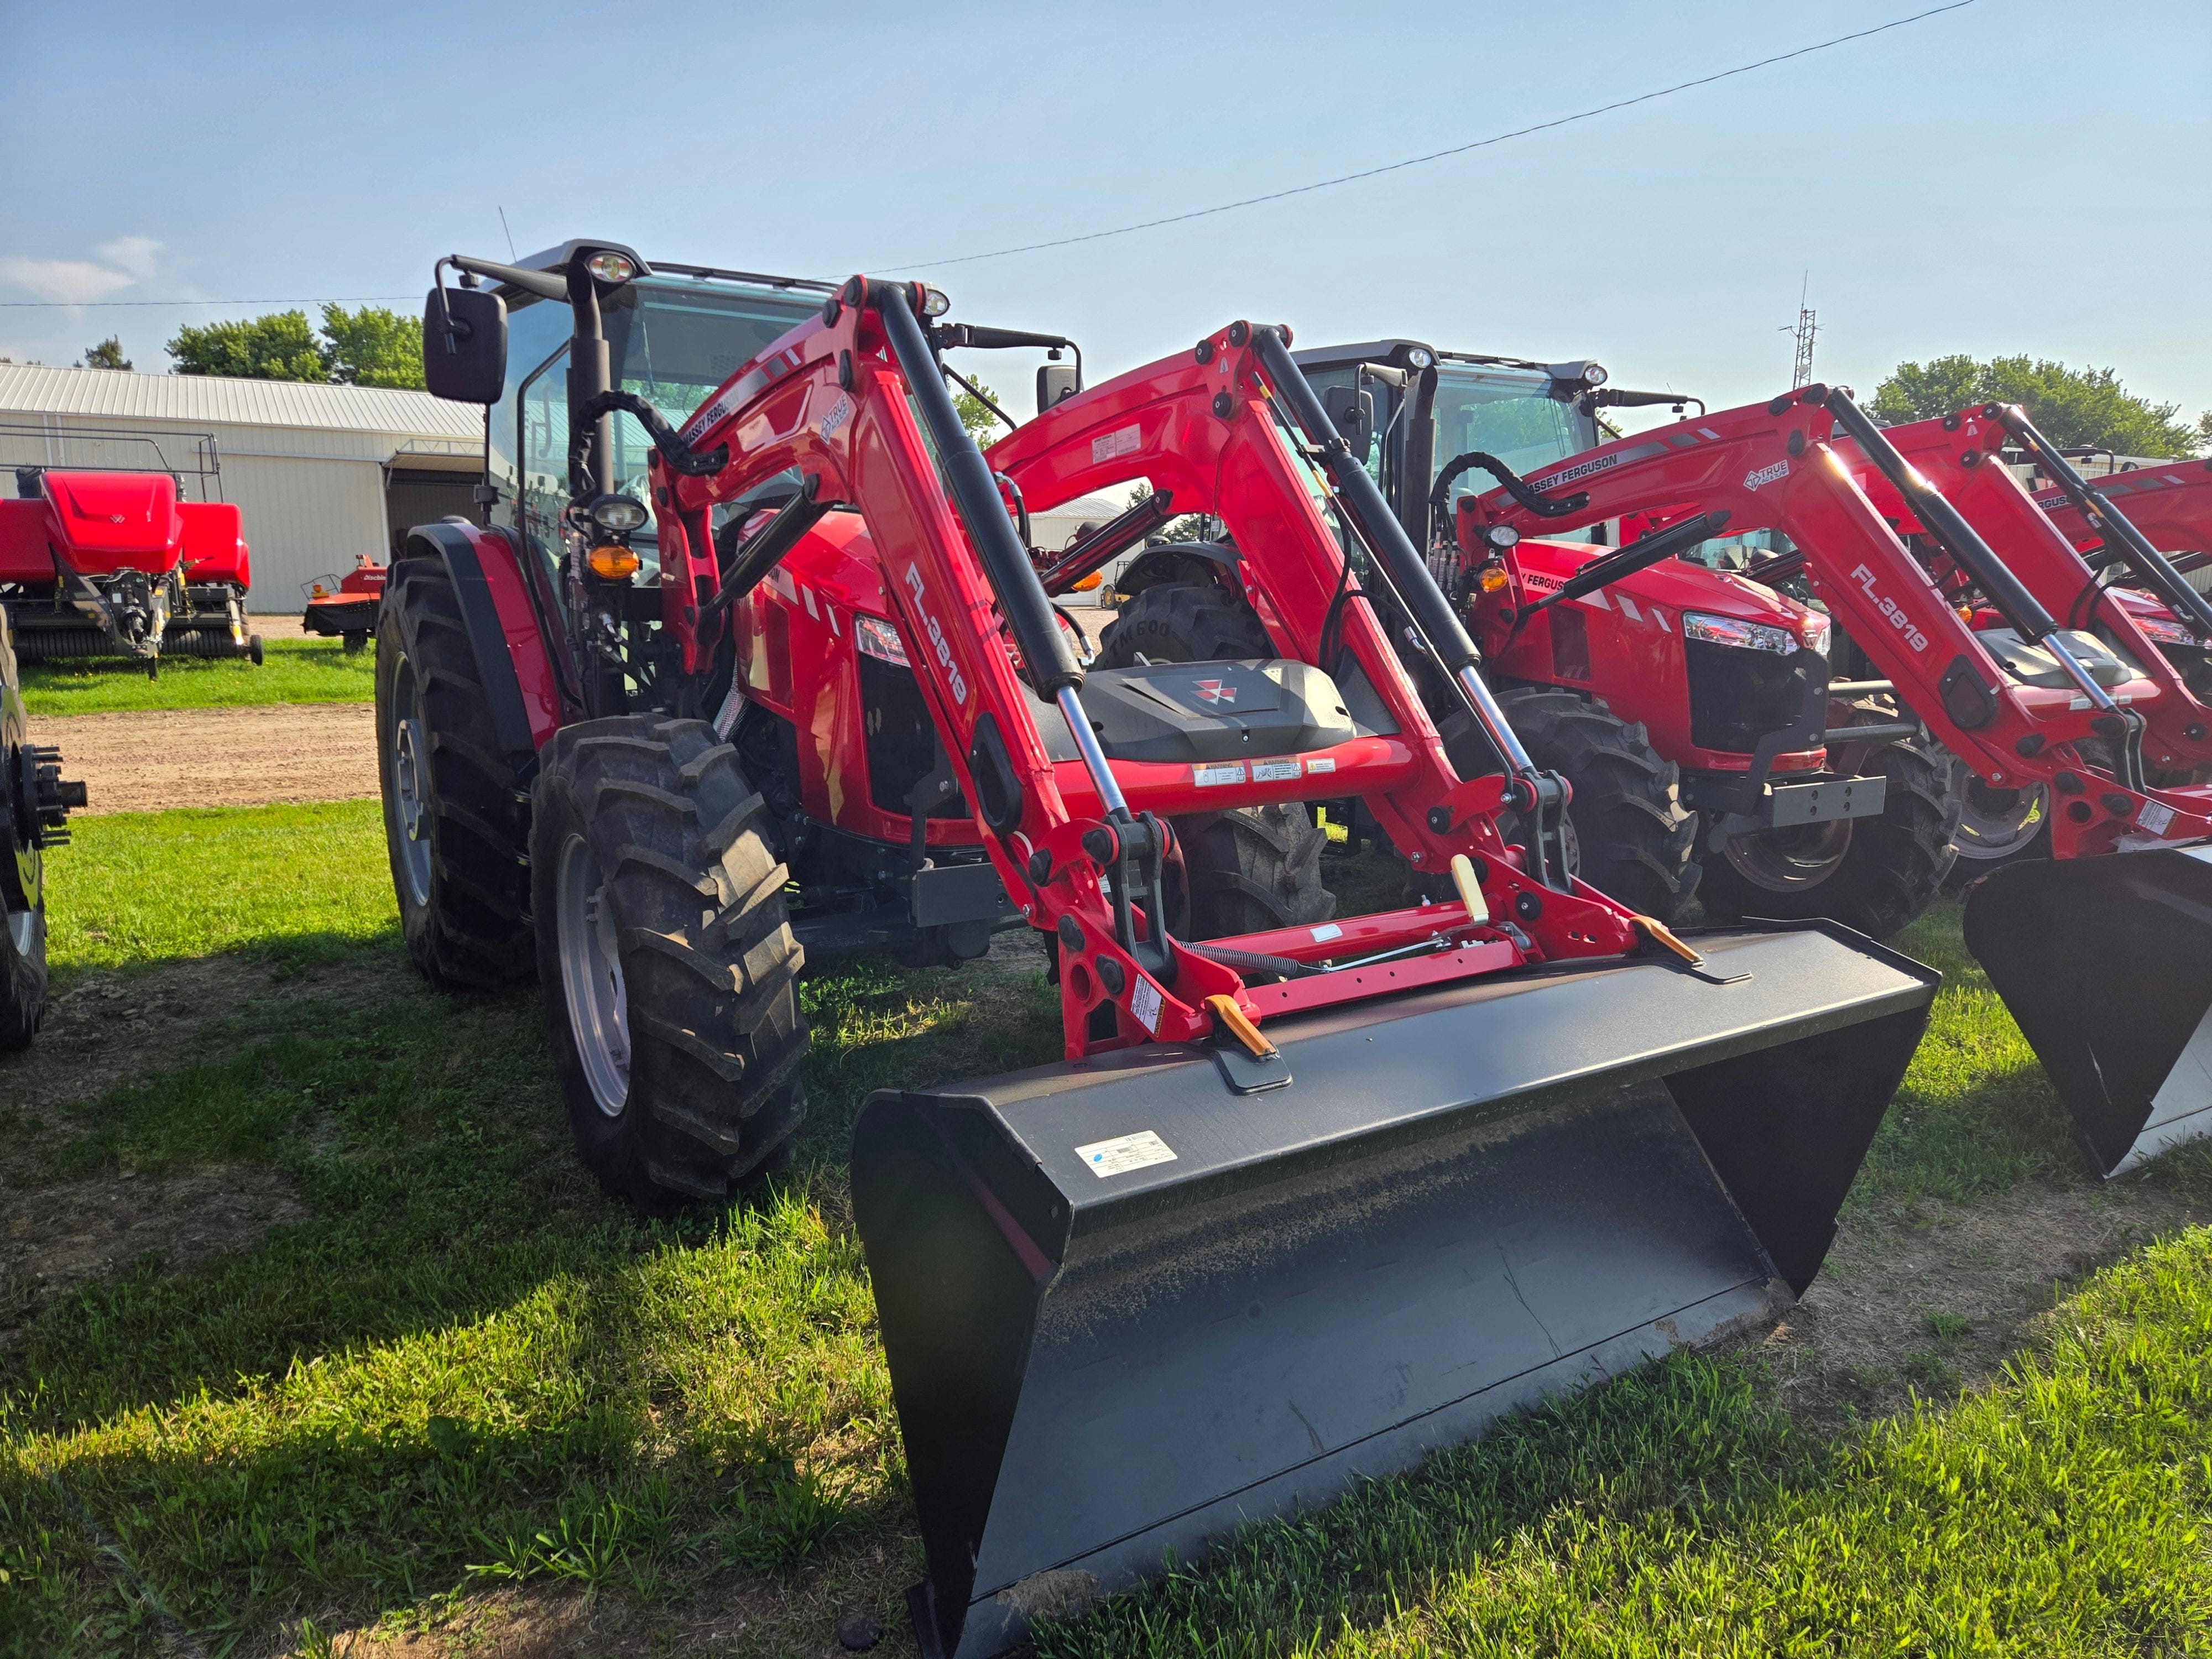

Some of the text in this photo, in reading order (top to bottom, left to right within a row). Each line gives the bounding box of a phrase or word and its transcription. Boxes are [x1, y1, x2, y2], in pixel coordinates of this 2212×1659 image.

[829, 393, 847, 422] TRUE
[1528, 454, 1618, 493] ASSEY FERGUSON
[1760, 461, 1787, 478] TRUE
[2037, 496, 2069, 509] RGUS
[1527, 574, 1564, 591] FERGUS
[1850, 563, 1929, 652] FL.3819
[905, 561, 967, 706] FL.3819
